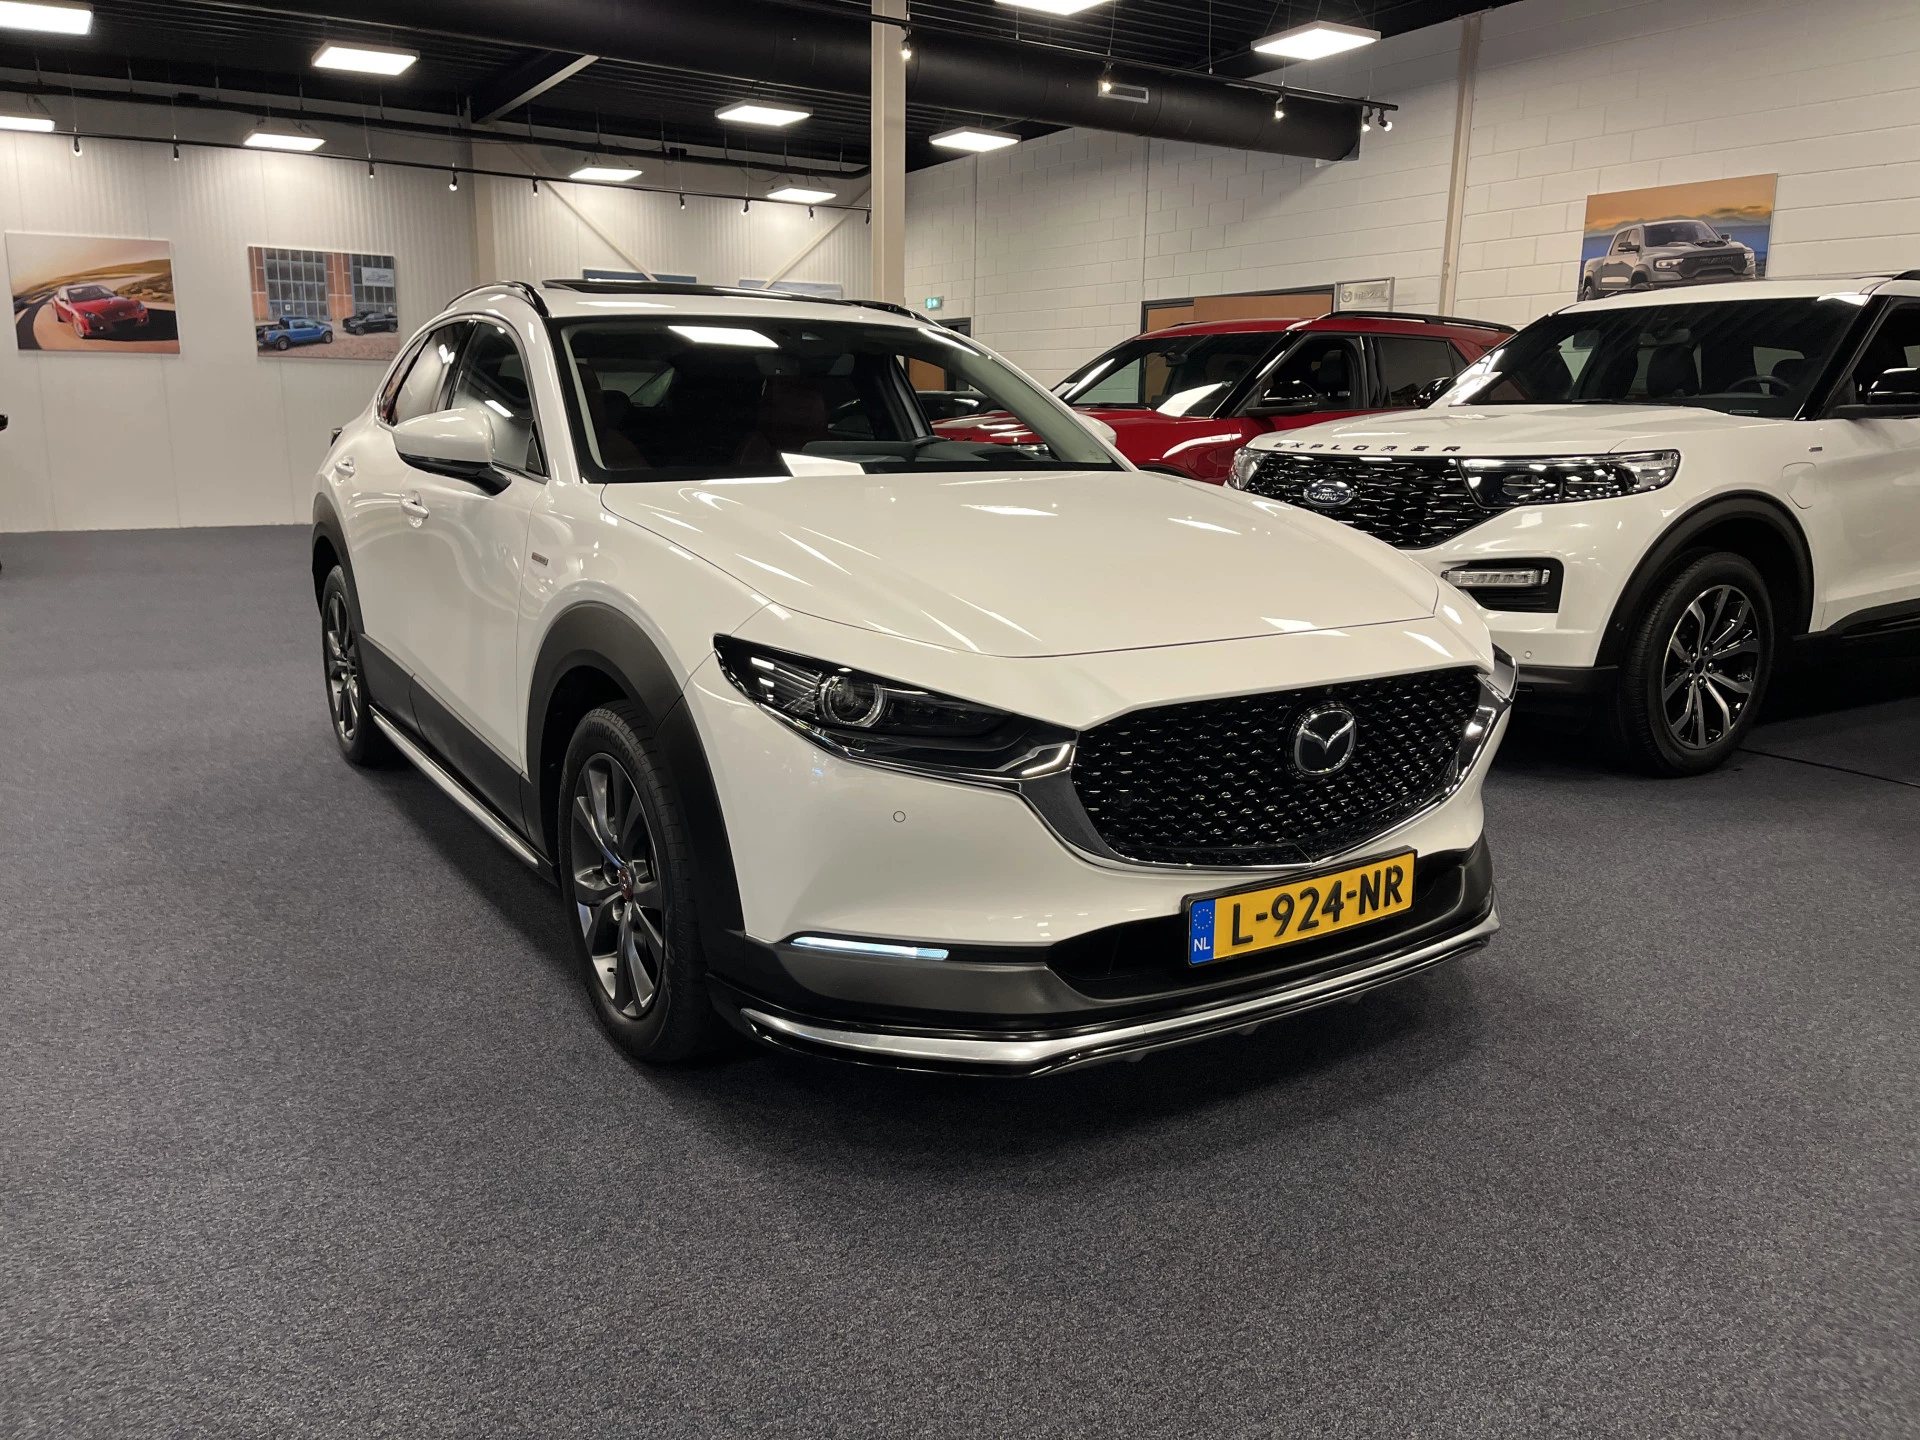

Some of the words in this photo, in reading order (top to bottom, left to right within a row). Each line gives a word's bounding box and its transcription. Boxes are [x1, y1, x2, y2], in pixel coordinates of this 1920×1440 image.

[1273, 442, 1462, 453] EXPLORER
[1231, 864, 1404, 946] L-924-NR
[1193, 936, 1211, 952] NL
